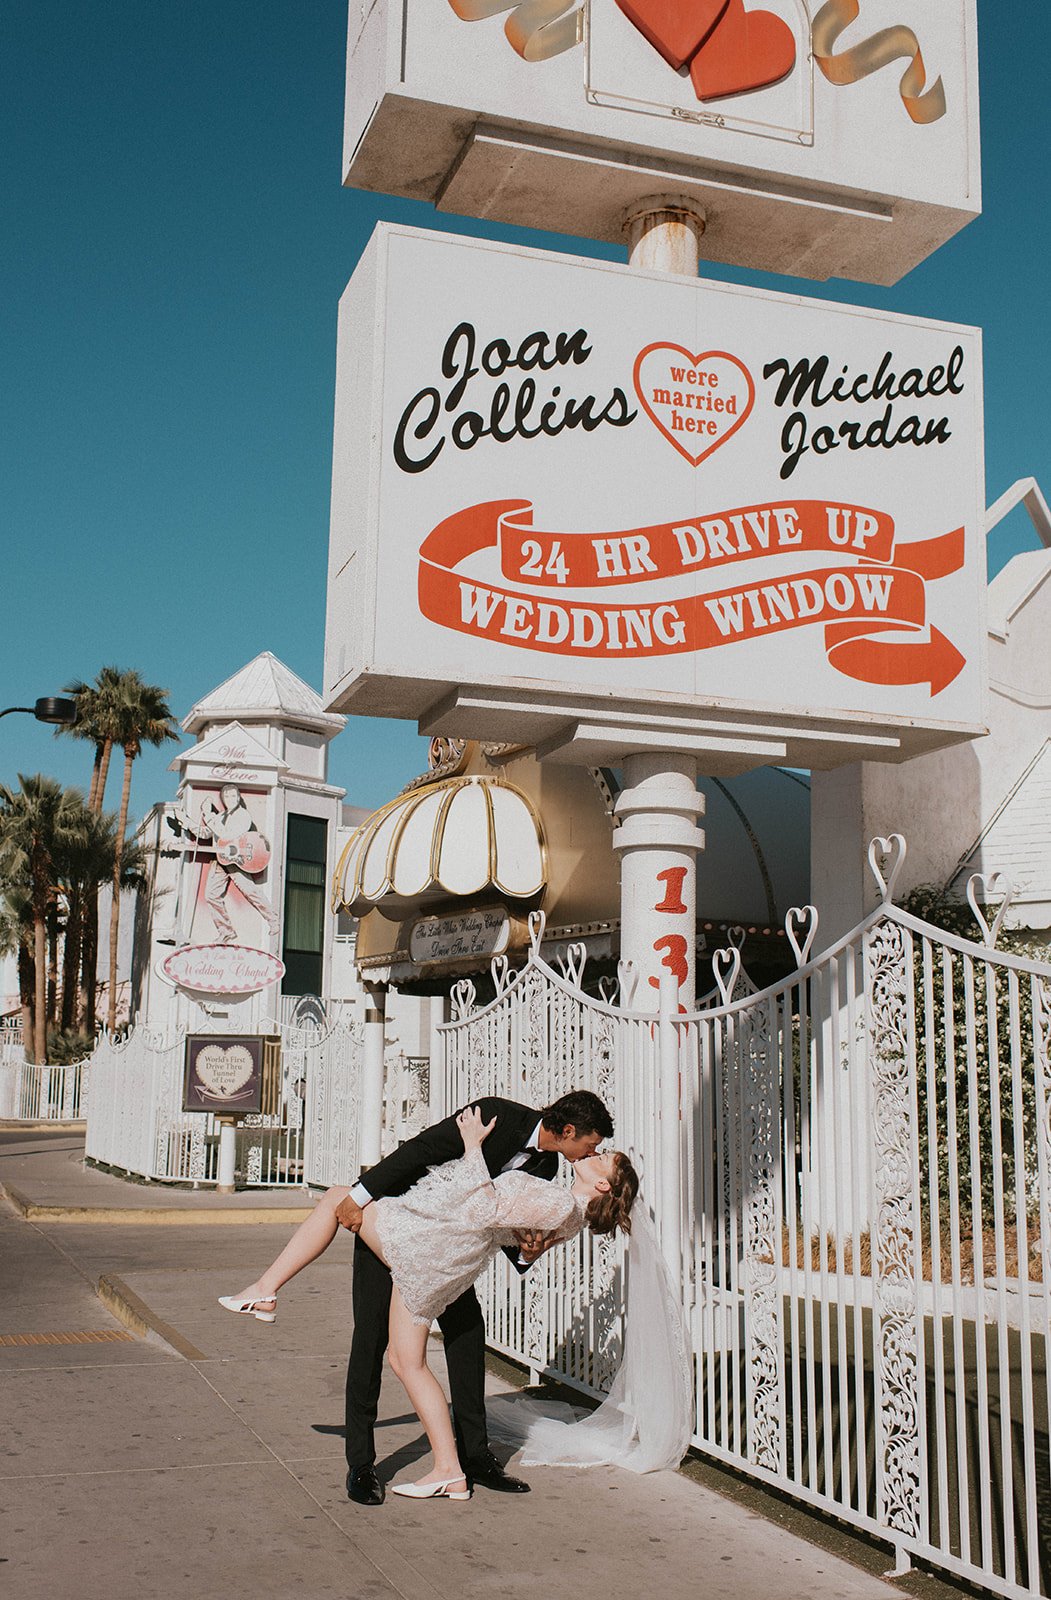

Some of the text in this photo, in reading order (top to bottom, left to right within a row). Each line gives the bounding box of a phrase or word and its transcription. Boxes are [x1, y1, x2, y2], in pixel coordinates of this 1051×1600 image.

[441, 322, 593, 412] Joan
[670, 367, 718, 388] were
[763, 345, 965, 409] Michael
[653, 389, 737, 415] married
[393, 377, 638, 474] Collins
[671, 410, 717, 435] here
[780, 404, 953, 480] Jordan
[519, 507, 880, 584] 24 HR DRIVE UP
[459, 574, 894, 650] WEDDING WINDOW
[218, 745, 248, 759] With
[209, 764, 258, 781] Love
[174, 960, 269, 981] Wedding Chapel
[204, 1055, 229, 1063] World's
